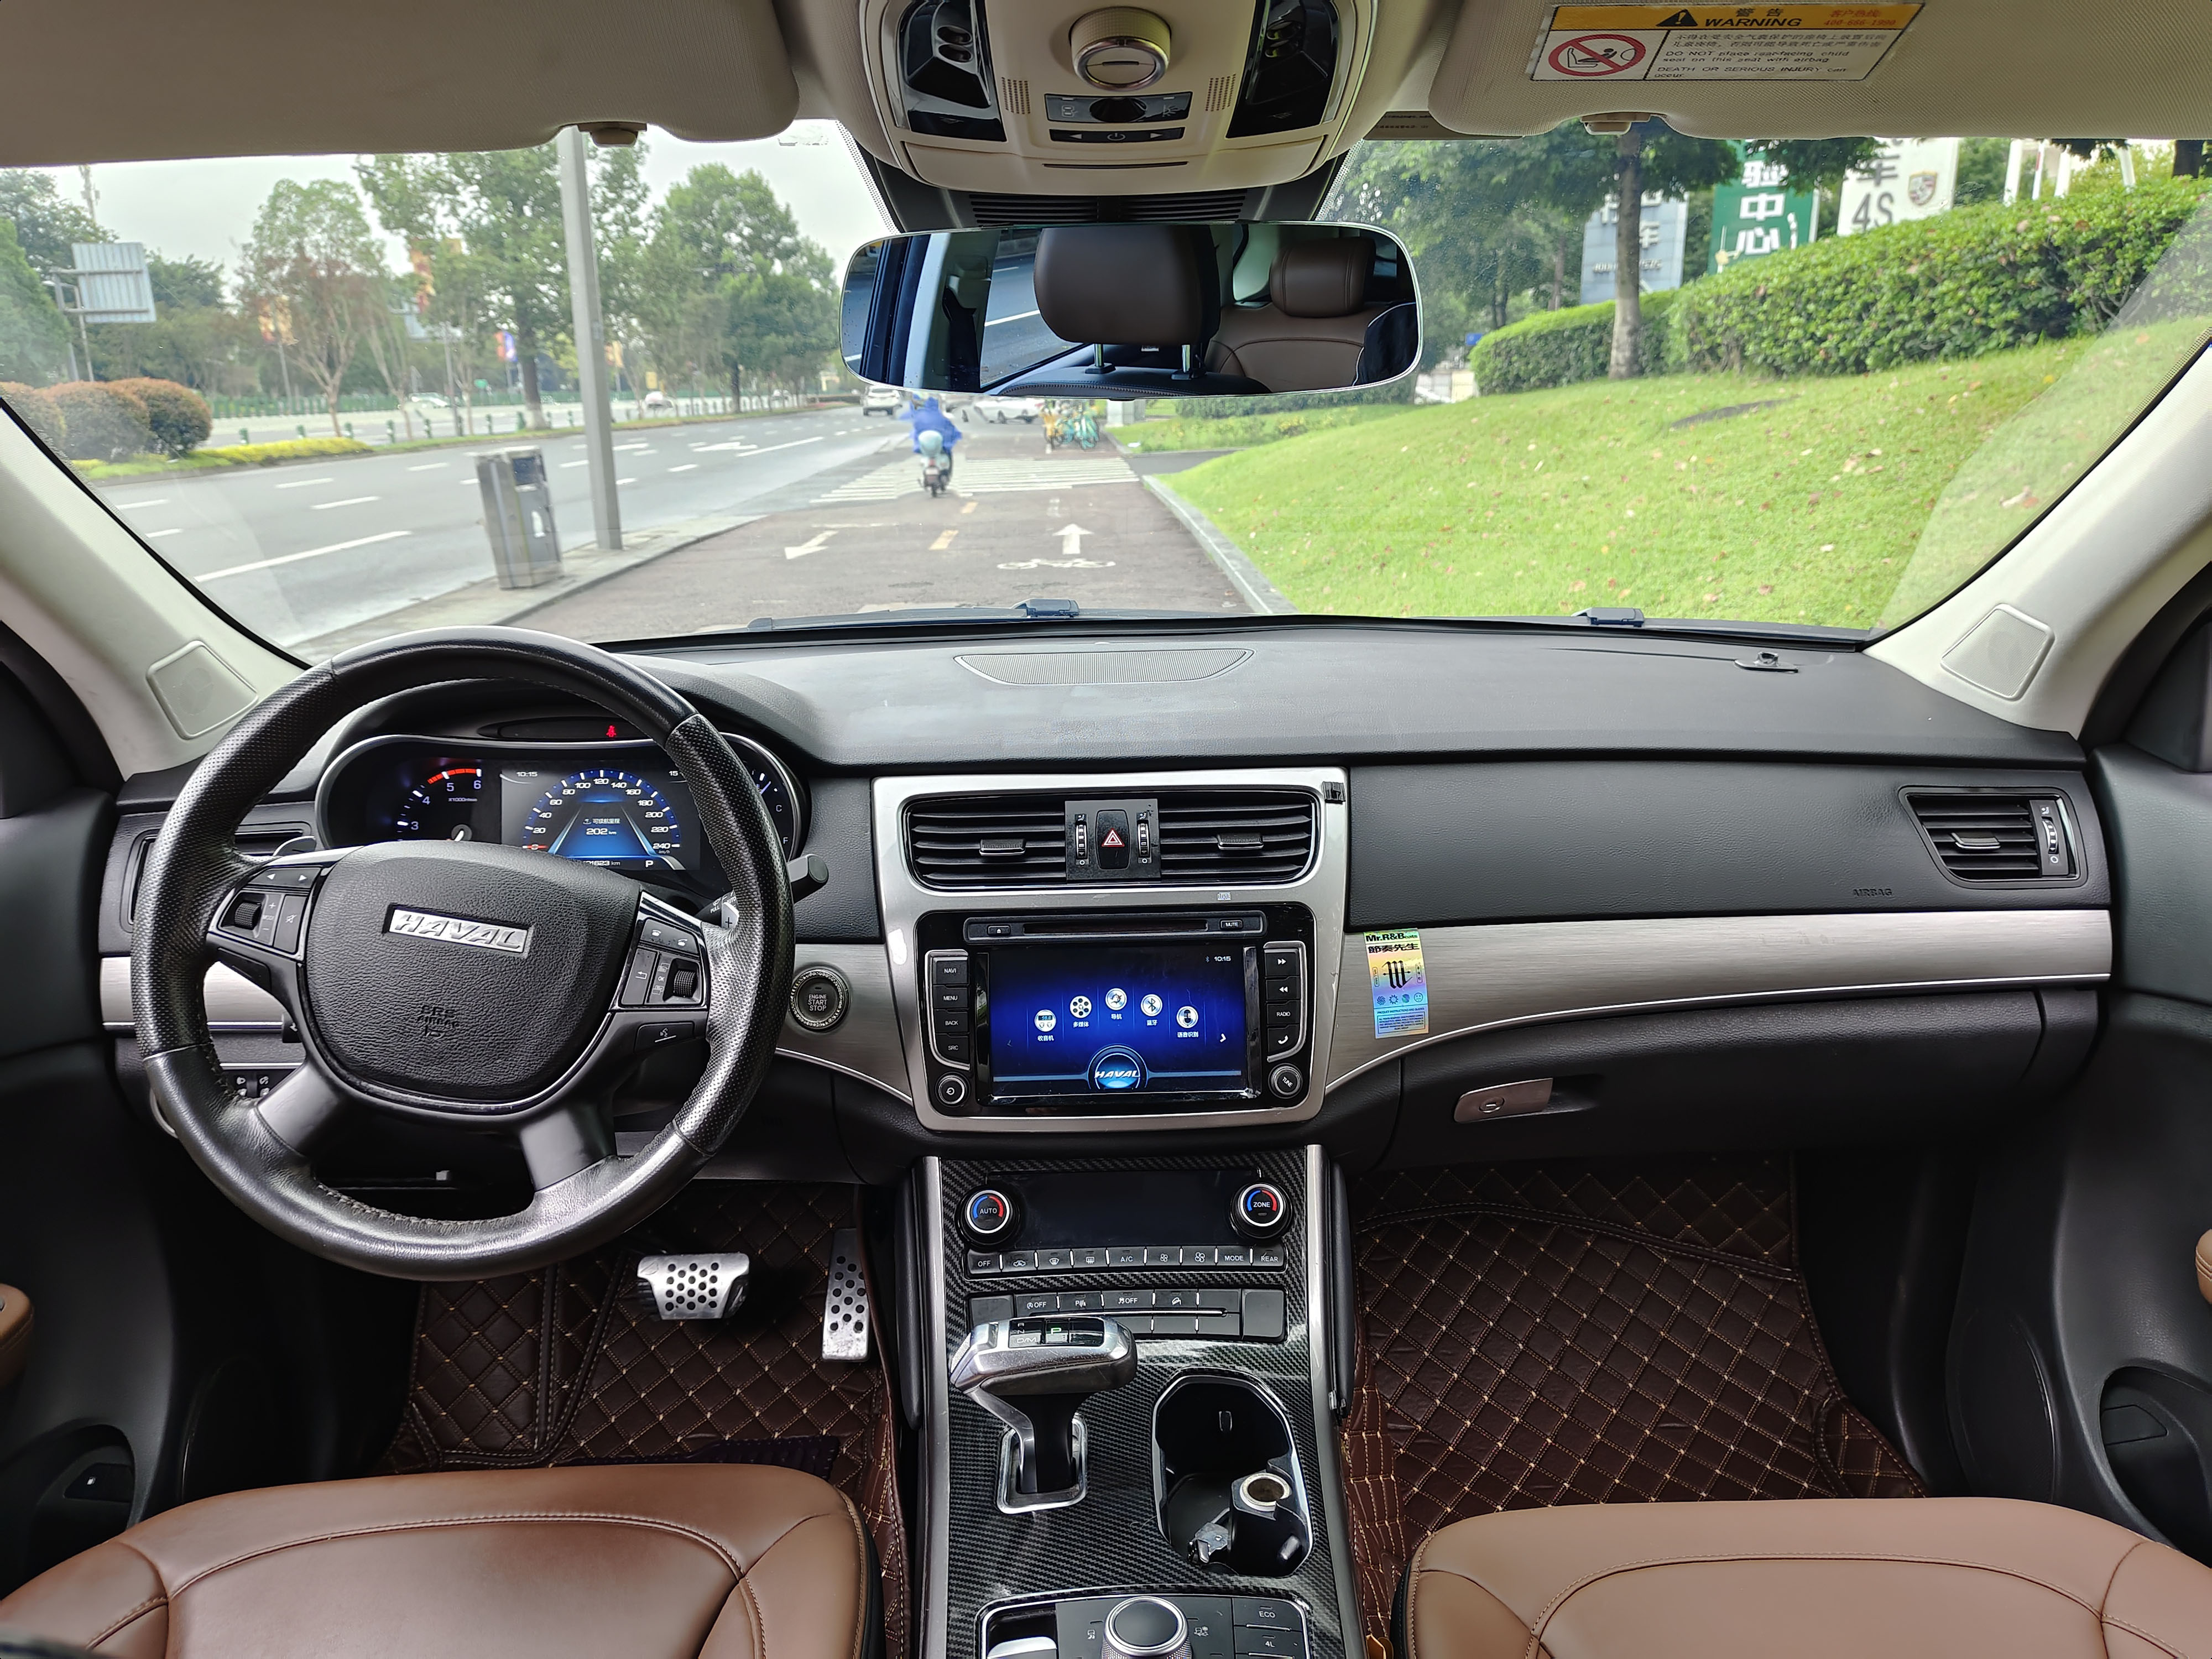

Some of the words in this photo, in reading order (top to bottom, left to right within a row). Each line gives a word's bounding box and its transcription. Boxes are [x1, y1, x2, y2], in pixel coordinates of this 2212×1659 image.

[1736, 8, 1784, 17] 警告
[1705, 18, 1802, 27] WARNING
[446, 782, 455, 791] 5
[473, 780, 481, 789] 6
[422, 796, 431, 805] 4
[411, 821, 419, 830] 3
[1853, 888, 1892, 896] AIRBAG
[394, 914, 521, 949] HAVAL
[1094, 1070, 1141, 1078] HAVAL
[1282, 1076, 1293, 1088] TUNE
